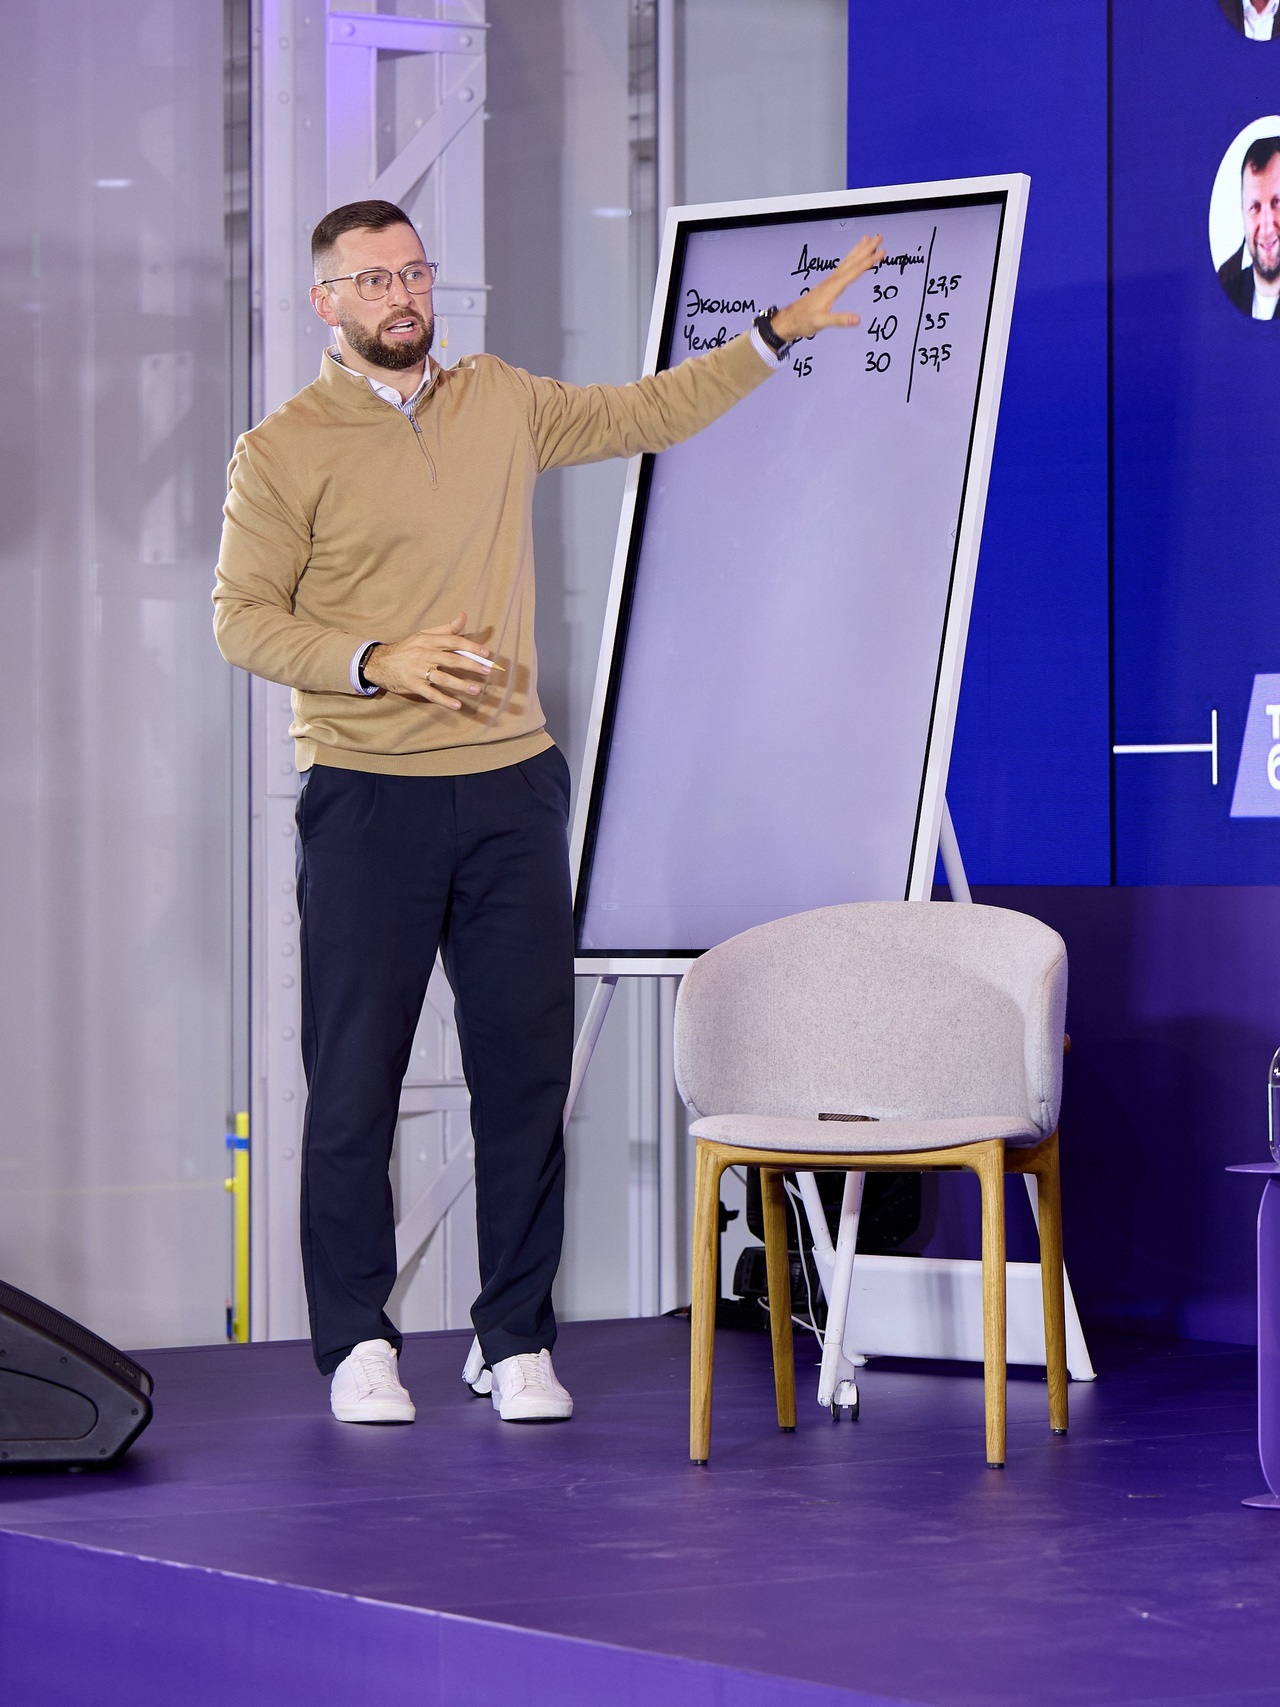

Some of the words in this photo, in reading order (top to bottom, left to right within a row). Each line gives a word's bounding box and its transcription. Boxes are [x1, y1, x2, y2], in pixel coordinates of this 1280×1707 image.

[791, 244, 840, 280] Денис
[866, 245, 925, 275] митрий
[873, 285, 898, 303] 30
[927, 274, 962, 298] 27,5
[867, 315, 898, 342] 40
[925, 312, 950, 330] 35
[793, 356, 813, 378] 45
[865, 351, 891, 372] 30
[918, 344, 952, 372] 37,5
